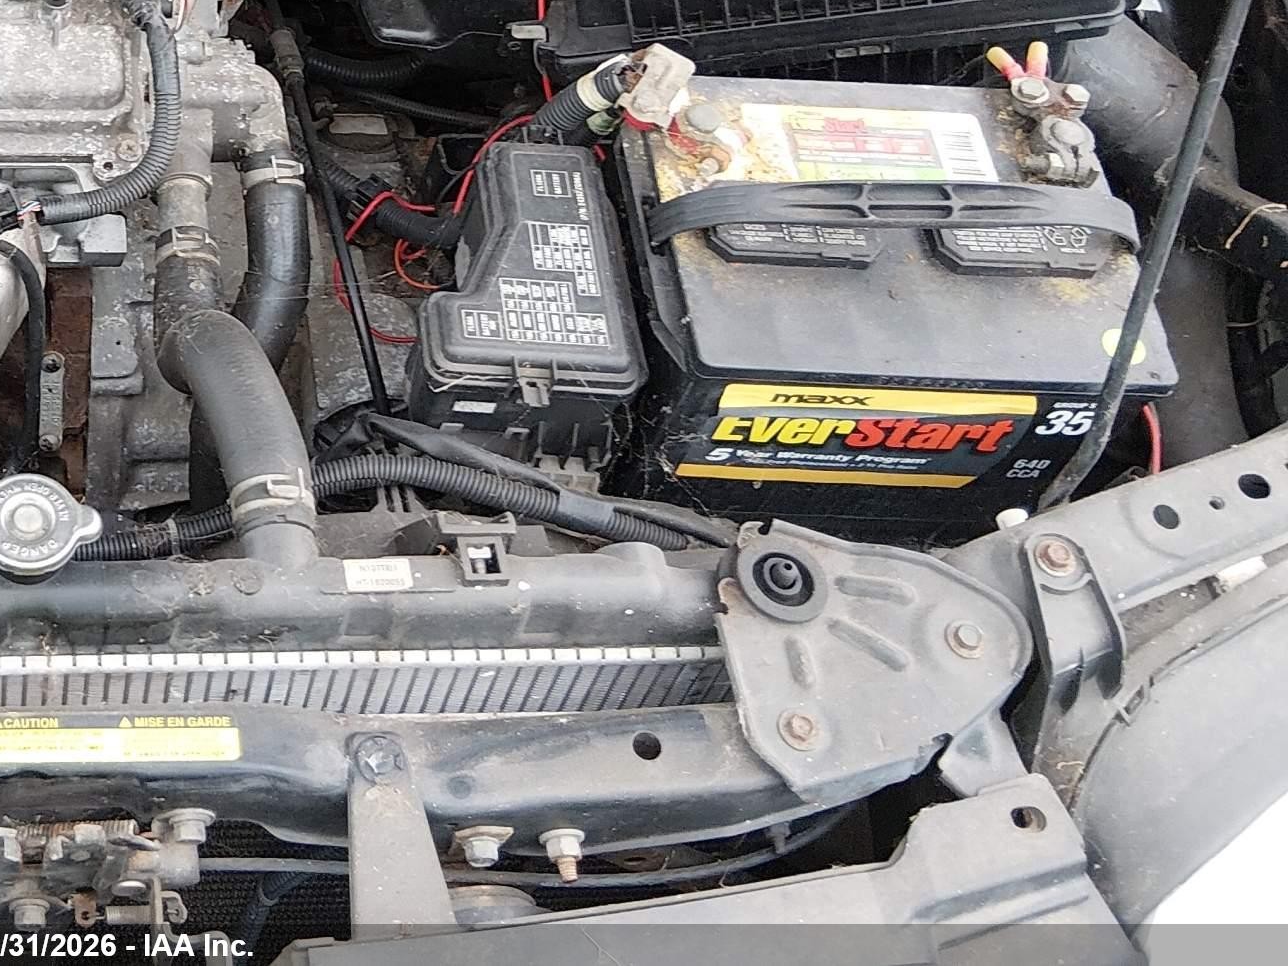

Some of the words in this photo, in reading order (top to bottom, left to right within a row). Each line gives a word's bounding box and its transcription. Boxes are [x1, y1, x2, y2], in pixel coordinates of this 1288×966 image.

[770, 393, 874, 406] maxx
[1035, 410, 1095, 436] 35
[711, 416, 1014, 453] EverStart
[704, 447, 734, 462] 5
[735, 449, 772, 459] Year
[776, 451, 855, 463] Warranty
[1013, 458, 1052, 469] 640
[1006, 468, 1041, 478] CCA
[1, 539, 58, 557] DANGER
[3, 718, 59, 728] CAUTION
[134, 717, 165, 727] MISE
[167, 717, 185, 727] EN
[187, 717, 232, 727] GARDE
